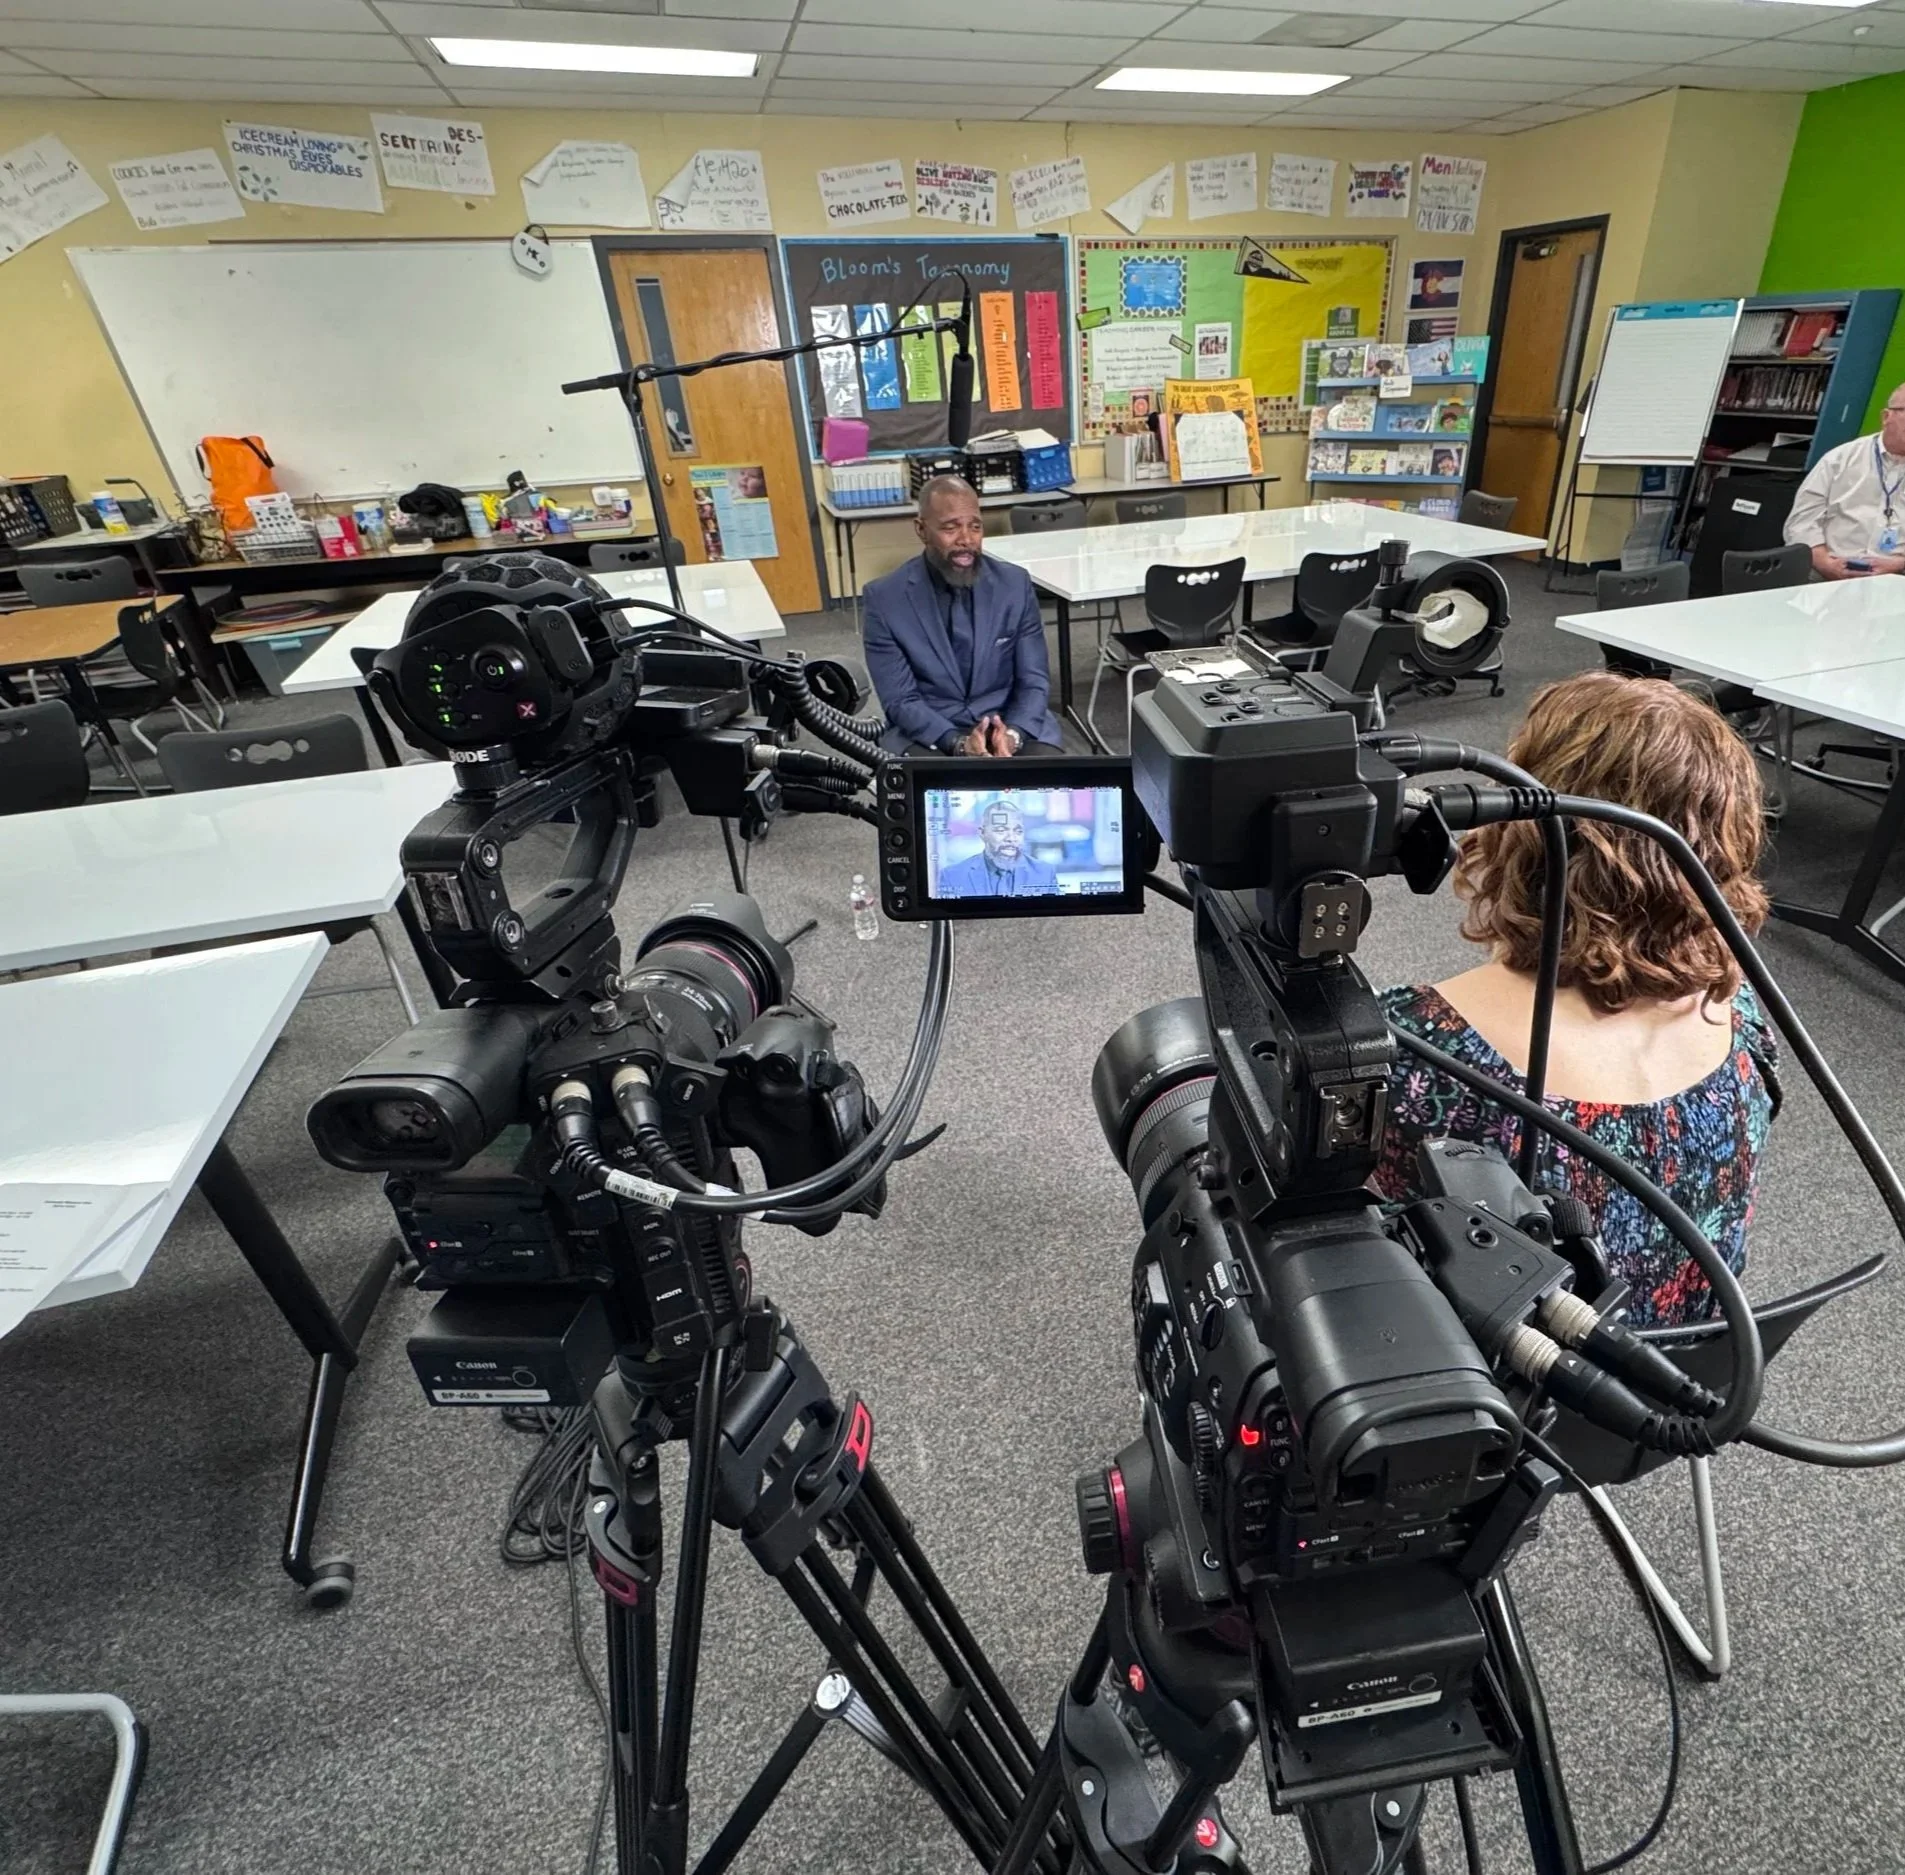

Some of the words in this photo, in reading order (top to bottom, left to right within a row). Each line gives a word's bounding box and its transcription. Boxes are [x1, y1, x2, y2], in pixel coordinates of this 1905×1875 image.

[821, 256, 901, 284] Bloom's
[892, 777, 897, 785] 1
[897, 900, 904, 908] 2
[456, 1361, 497, 1369] Canon
[1347, 1676, 1398, 1690] Canon
[1308, 1710, 1355, 1724] BP-A60
